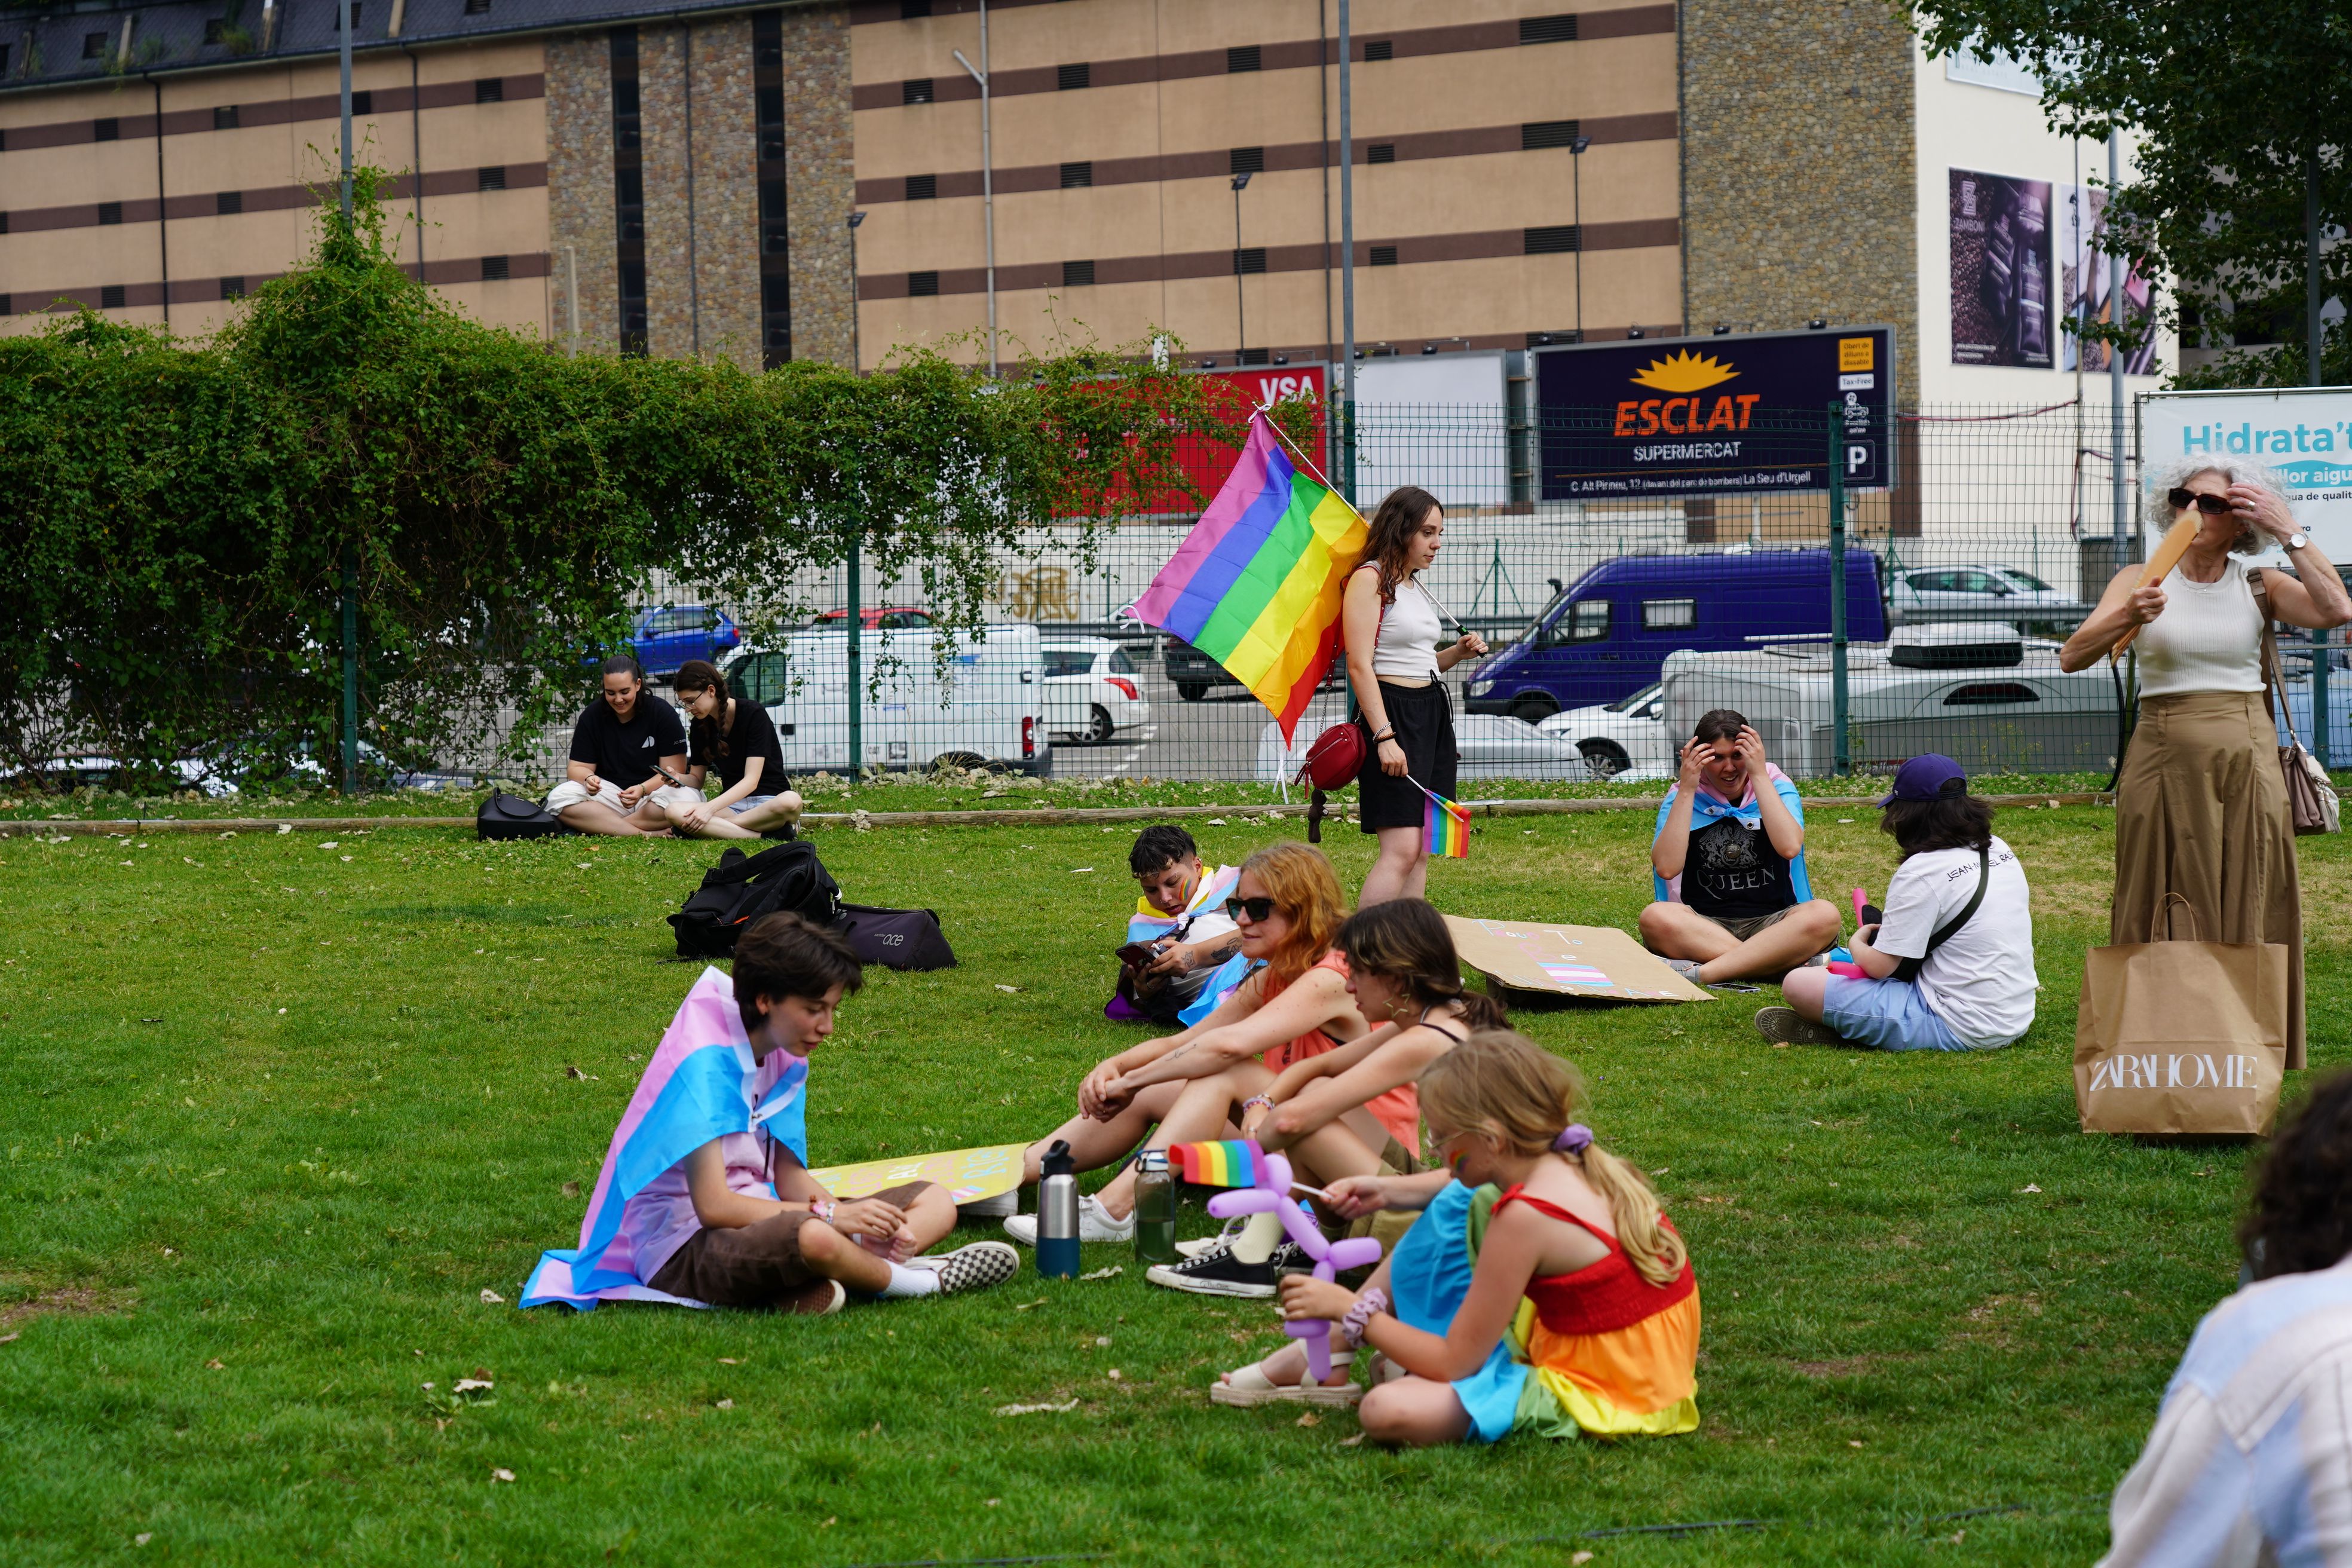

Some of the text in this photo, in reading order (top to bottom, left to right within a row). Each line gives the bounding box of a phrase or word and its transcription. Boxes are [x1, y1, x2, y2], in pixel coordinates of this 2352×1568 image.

[1953, 218, 1985, 232] ZAMBONI
[1259, 376, 1317, 406] VSA
[1613, 394, 1760, 437] ESCLAT
[1633, 442, 1741, 462] SUPERMERCAT
[1849, 446, 1868, 474] P
[1743, 474, 1755, 485] La
[2307, 492, 2319, 500] de
[1697, 865, 1777, 900] QUEEN
[883, 933, 904, 946] ace
